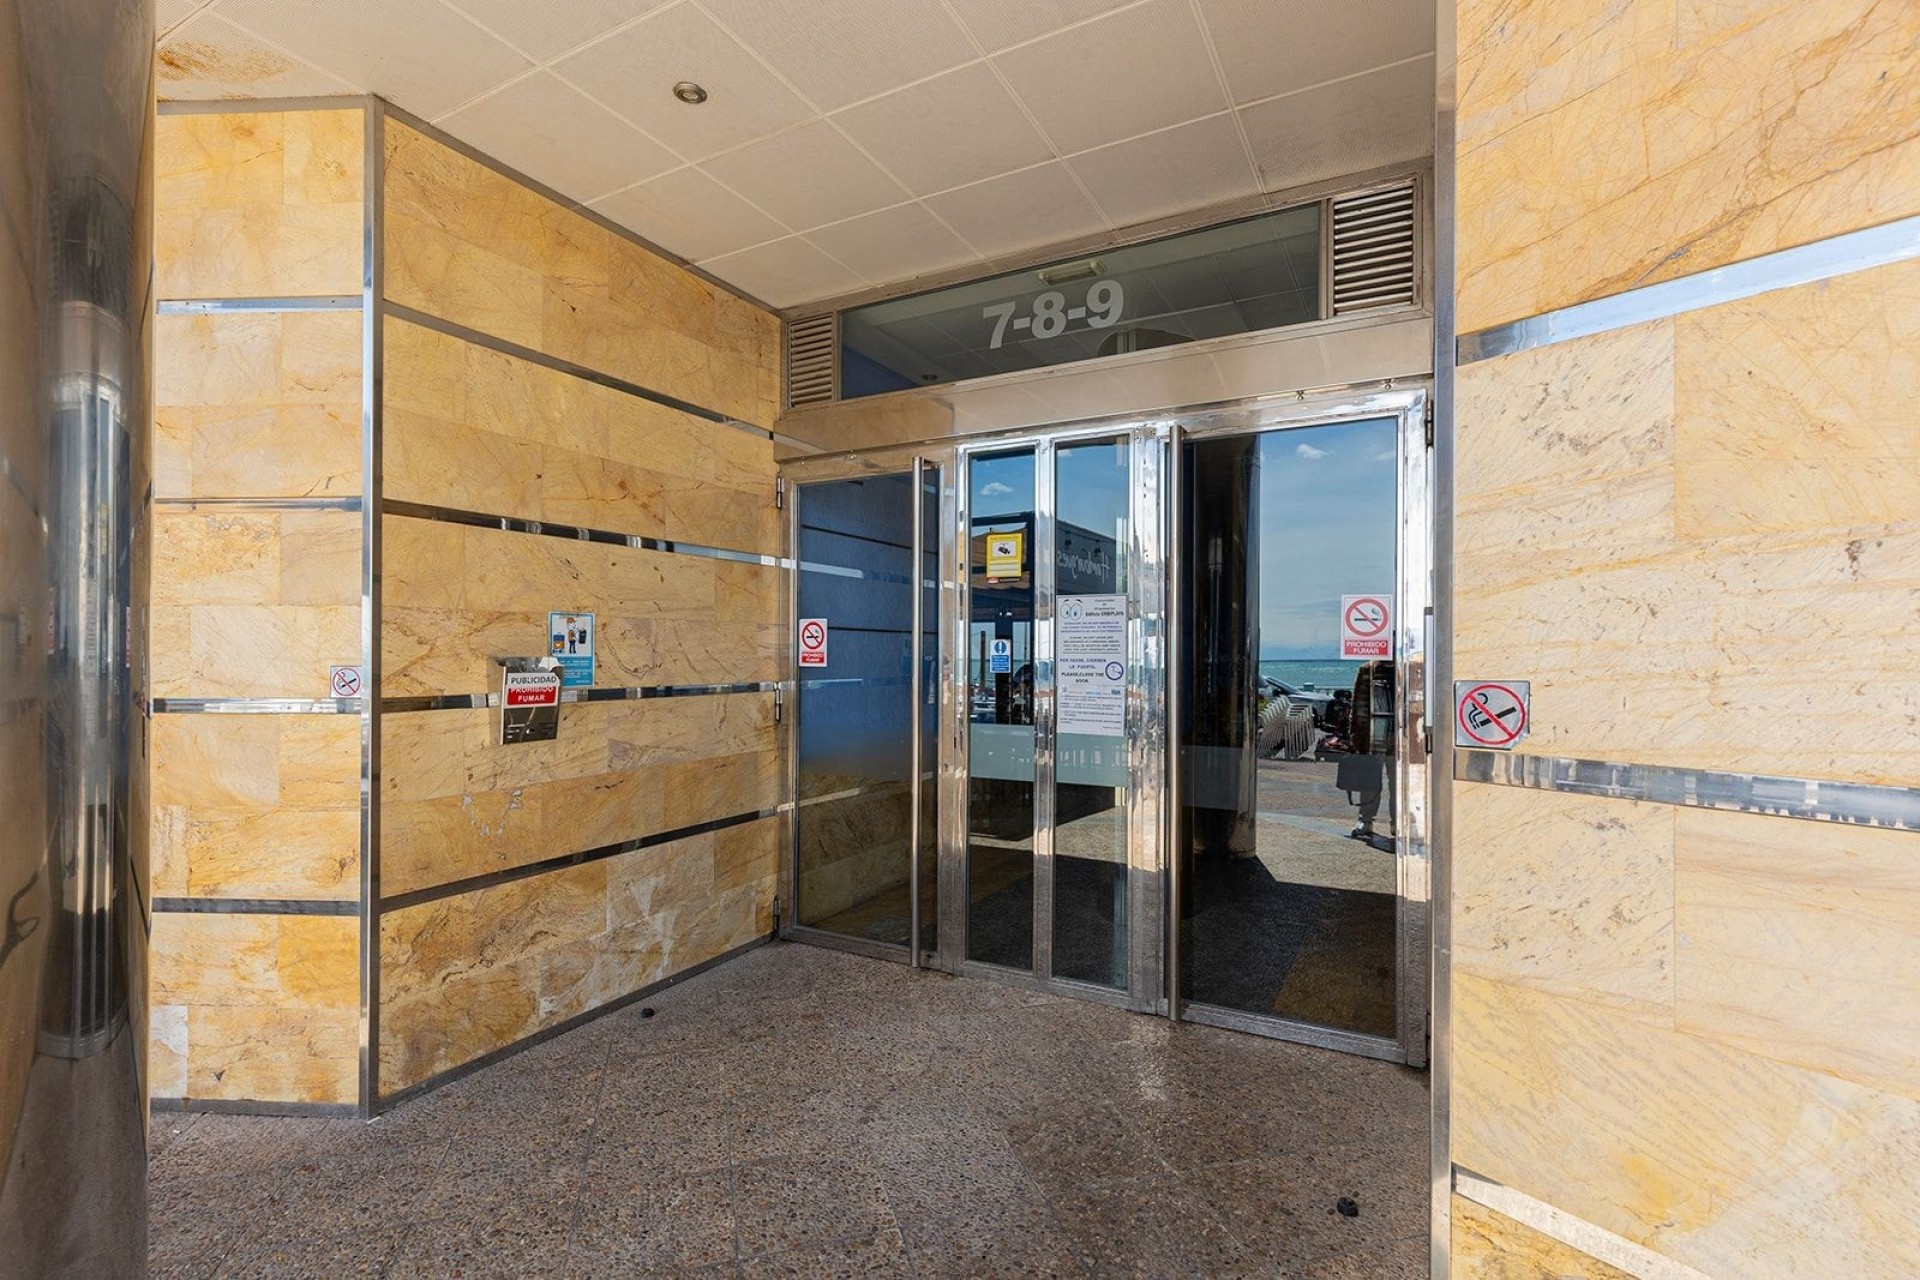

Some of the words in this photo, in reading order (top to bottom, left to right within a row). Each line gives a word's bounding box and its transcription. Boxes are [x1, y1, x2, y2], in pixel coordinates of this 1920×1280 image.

[983, 279, 1124, 350] 7-8-9
[511, 676, 557, 685] PUBLICIDAD
[517, 694, 546, 702] FUMAR
